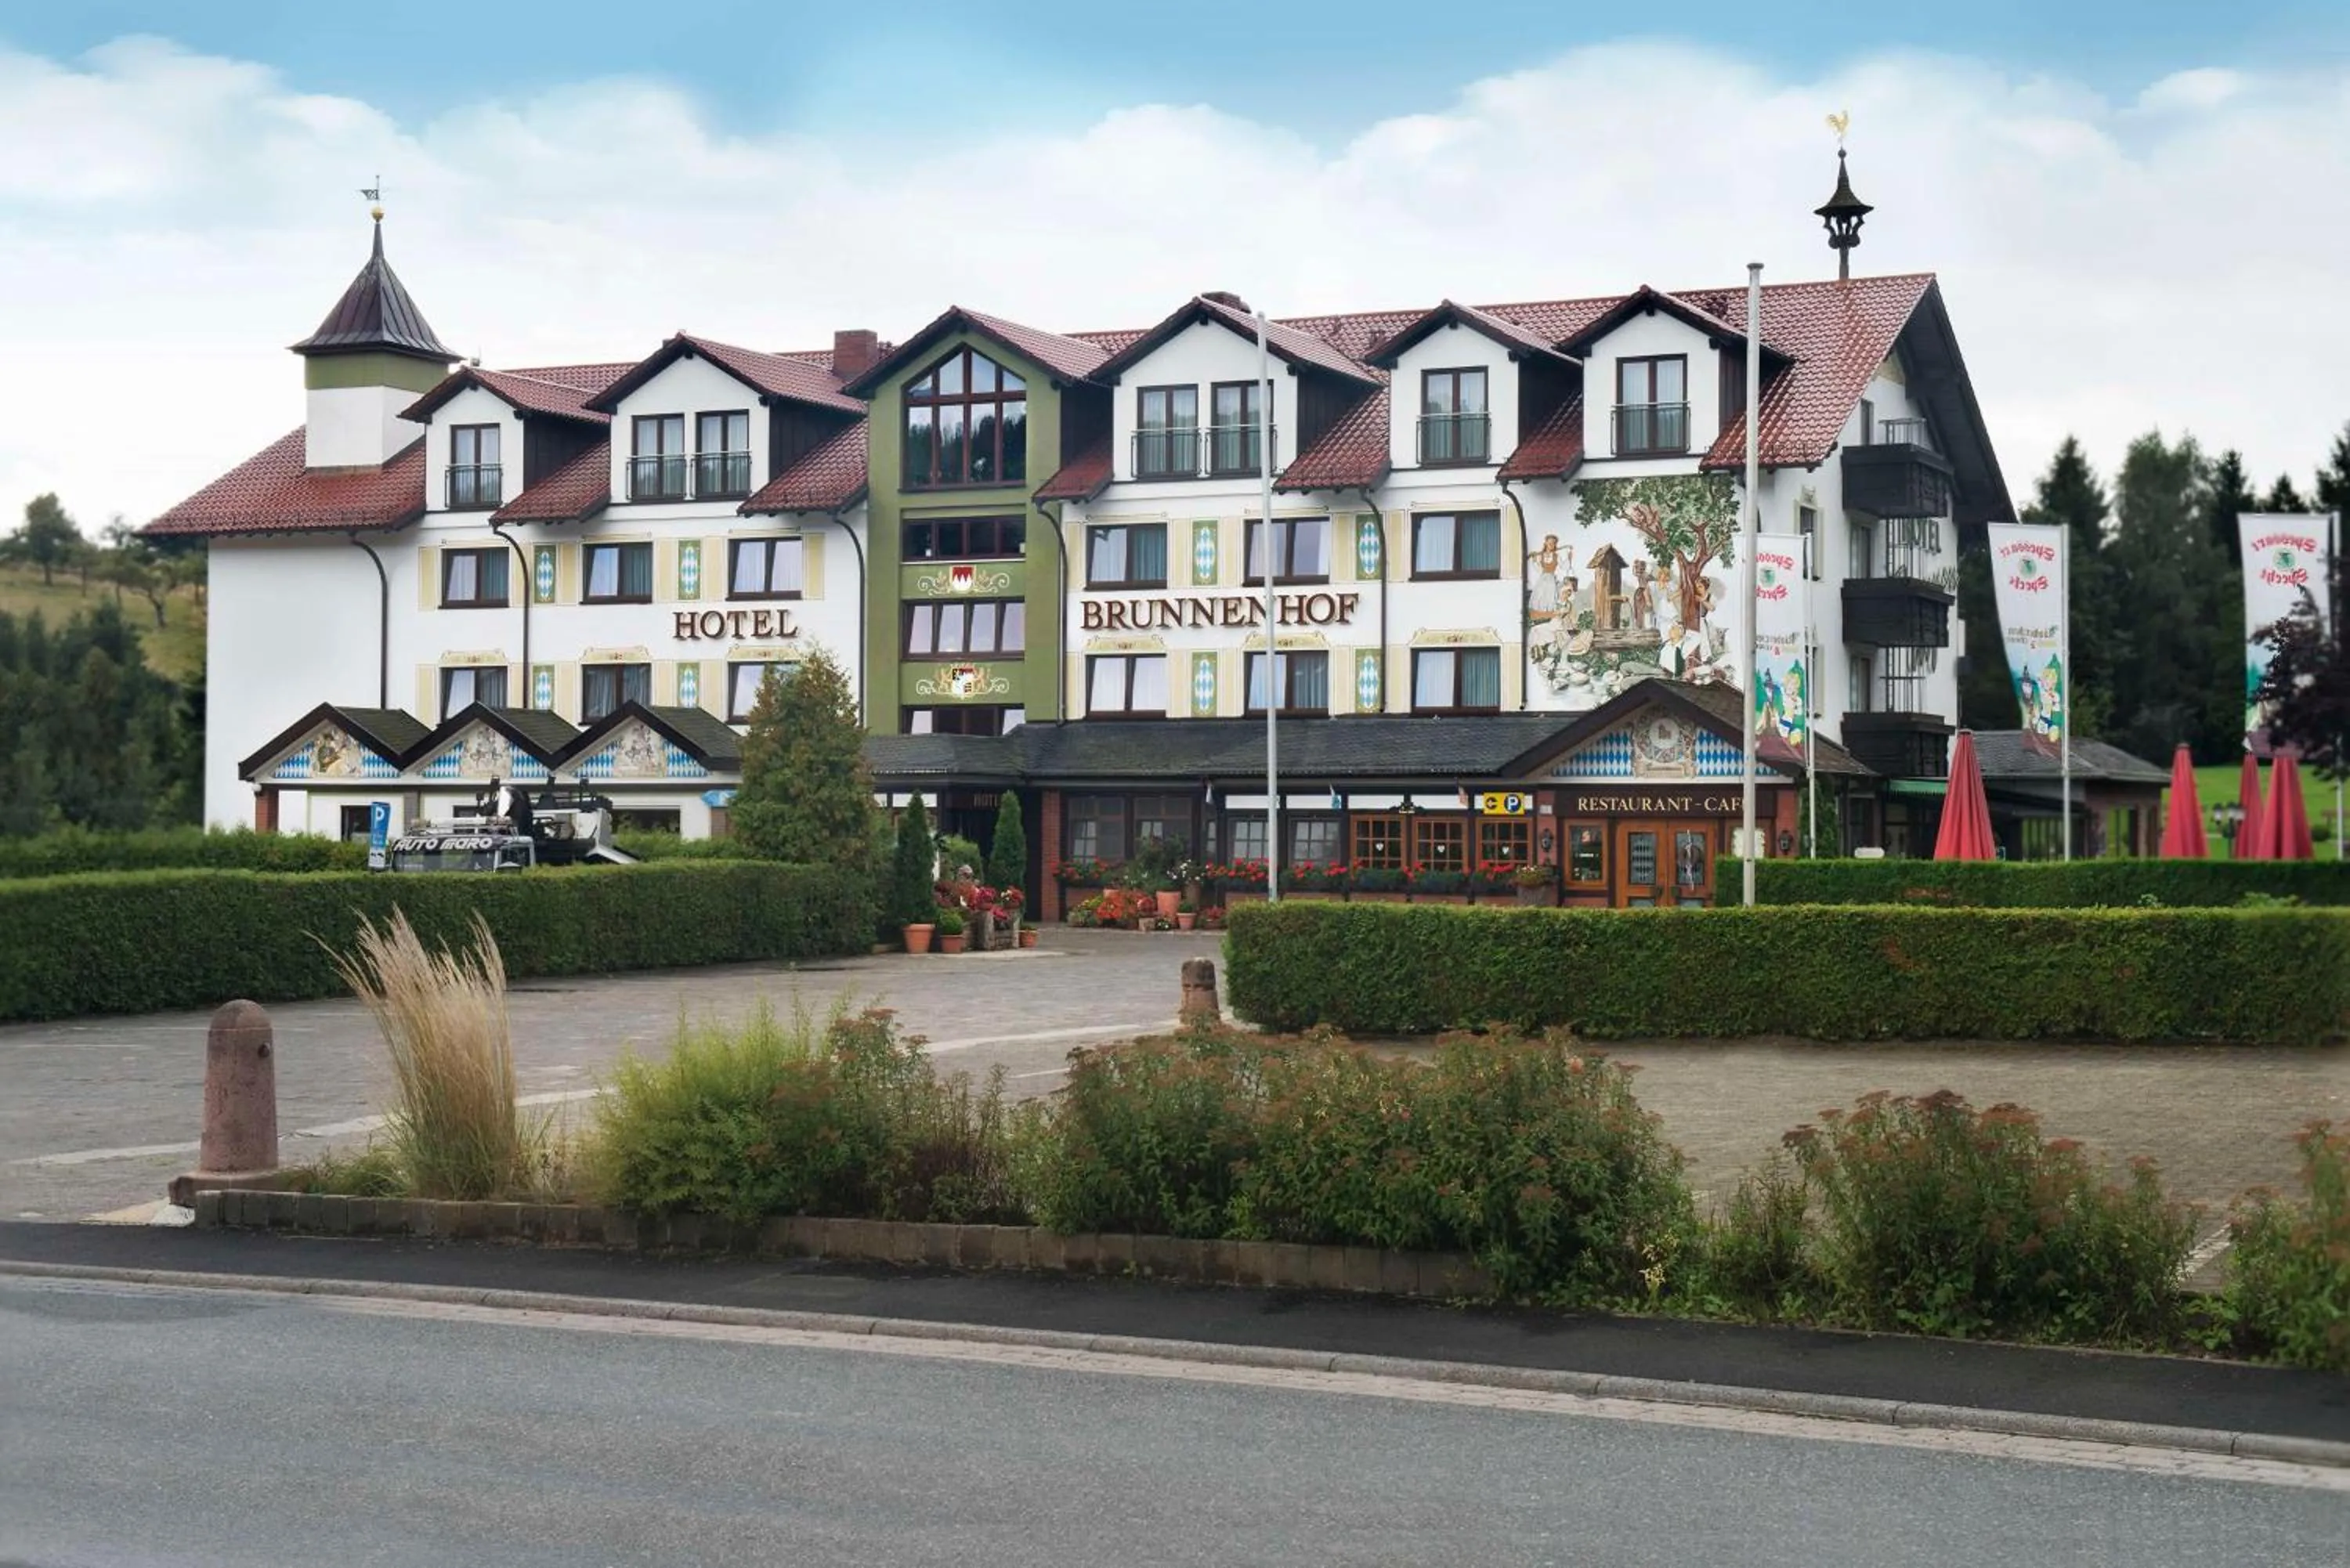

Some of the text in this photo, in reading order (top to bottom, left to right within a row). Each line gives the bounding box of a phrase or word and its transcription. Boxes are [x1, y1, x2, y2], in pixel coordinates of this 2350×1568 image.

[1081, 592, 1360, 630] BRUNNENHOF
[672, 609, 799, 641] HOTEL
[1507, 796, 1519, 811] P
[1578, 796, 1693, 812] RESTAURANT
[1704, 796, 1744, 812] CAF
[374, 806, 385, 829] P
[393, 837, 439, 851] AUTO
